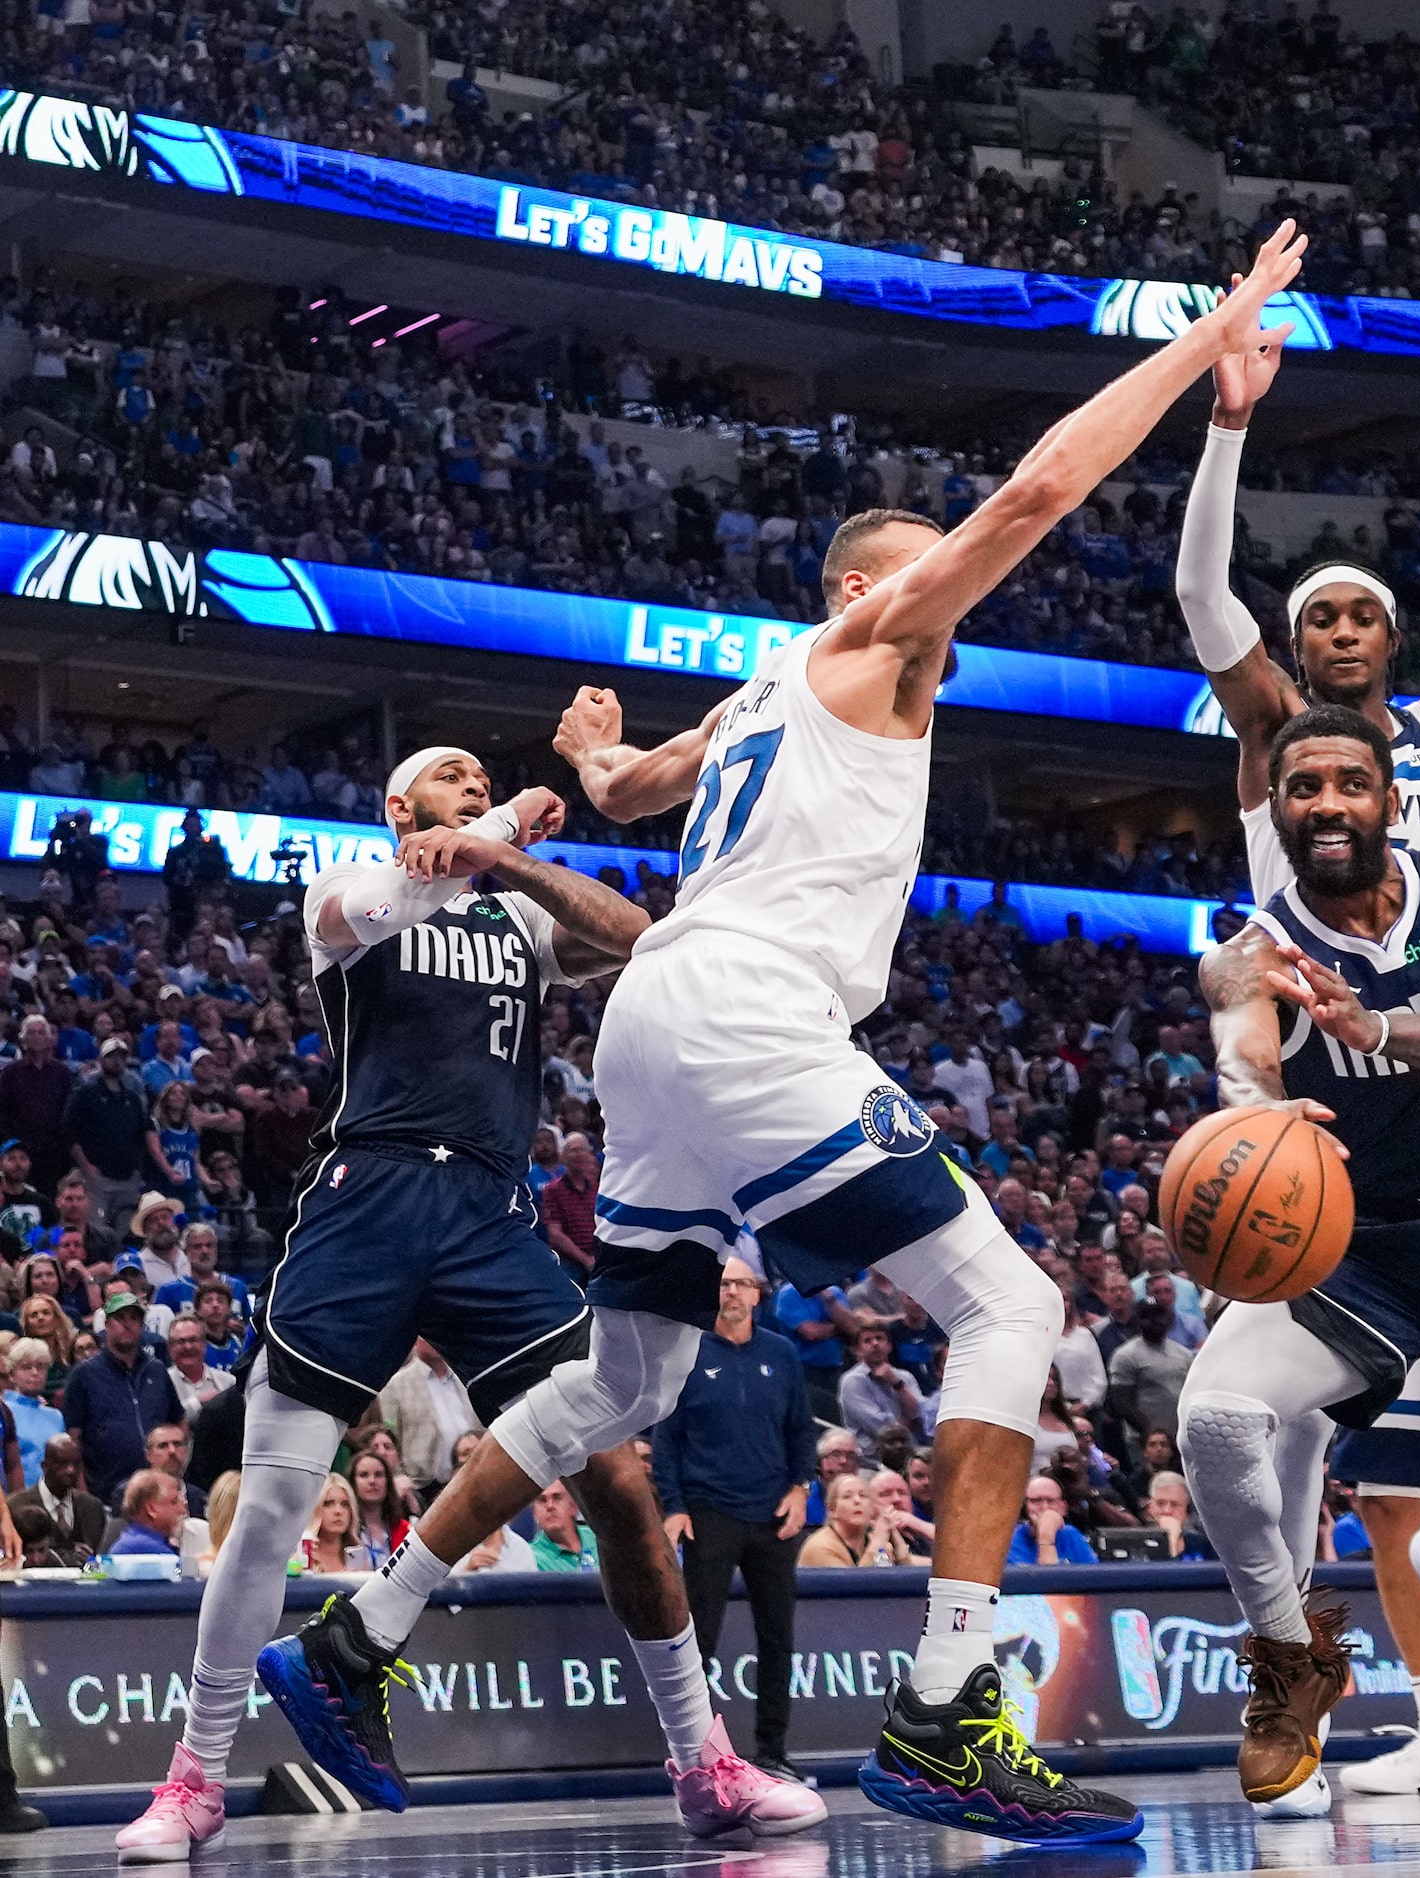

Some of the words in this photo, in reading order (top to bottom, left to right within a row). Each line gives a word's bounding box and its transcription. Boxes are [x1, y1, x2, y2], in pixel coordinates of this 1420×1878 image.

[677, 722, 785, 892] 27
[489, 994, 527, 1065] 21
[5, 1677, 42, 1728] A
[411, 1659, 545, 1712] WILL
[561, 1657, 628, 1708] BE
